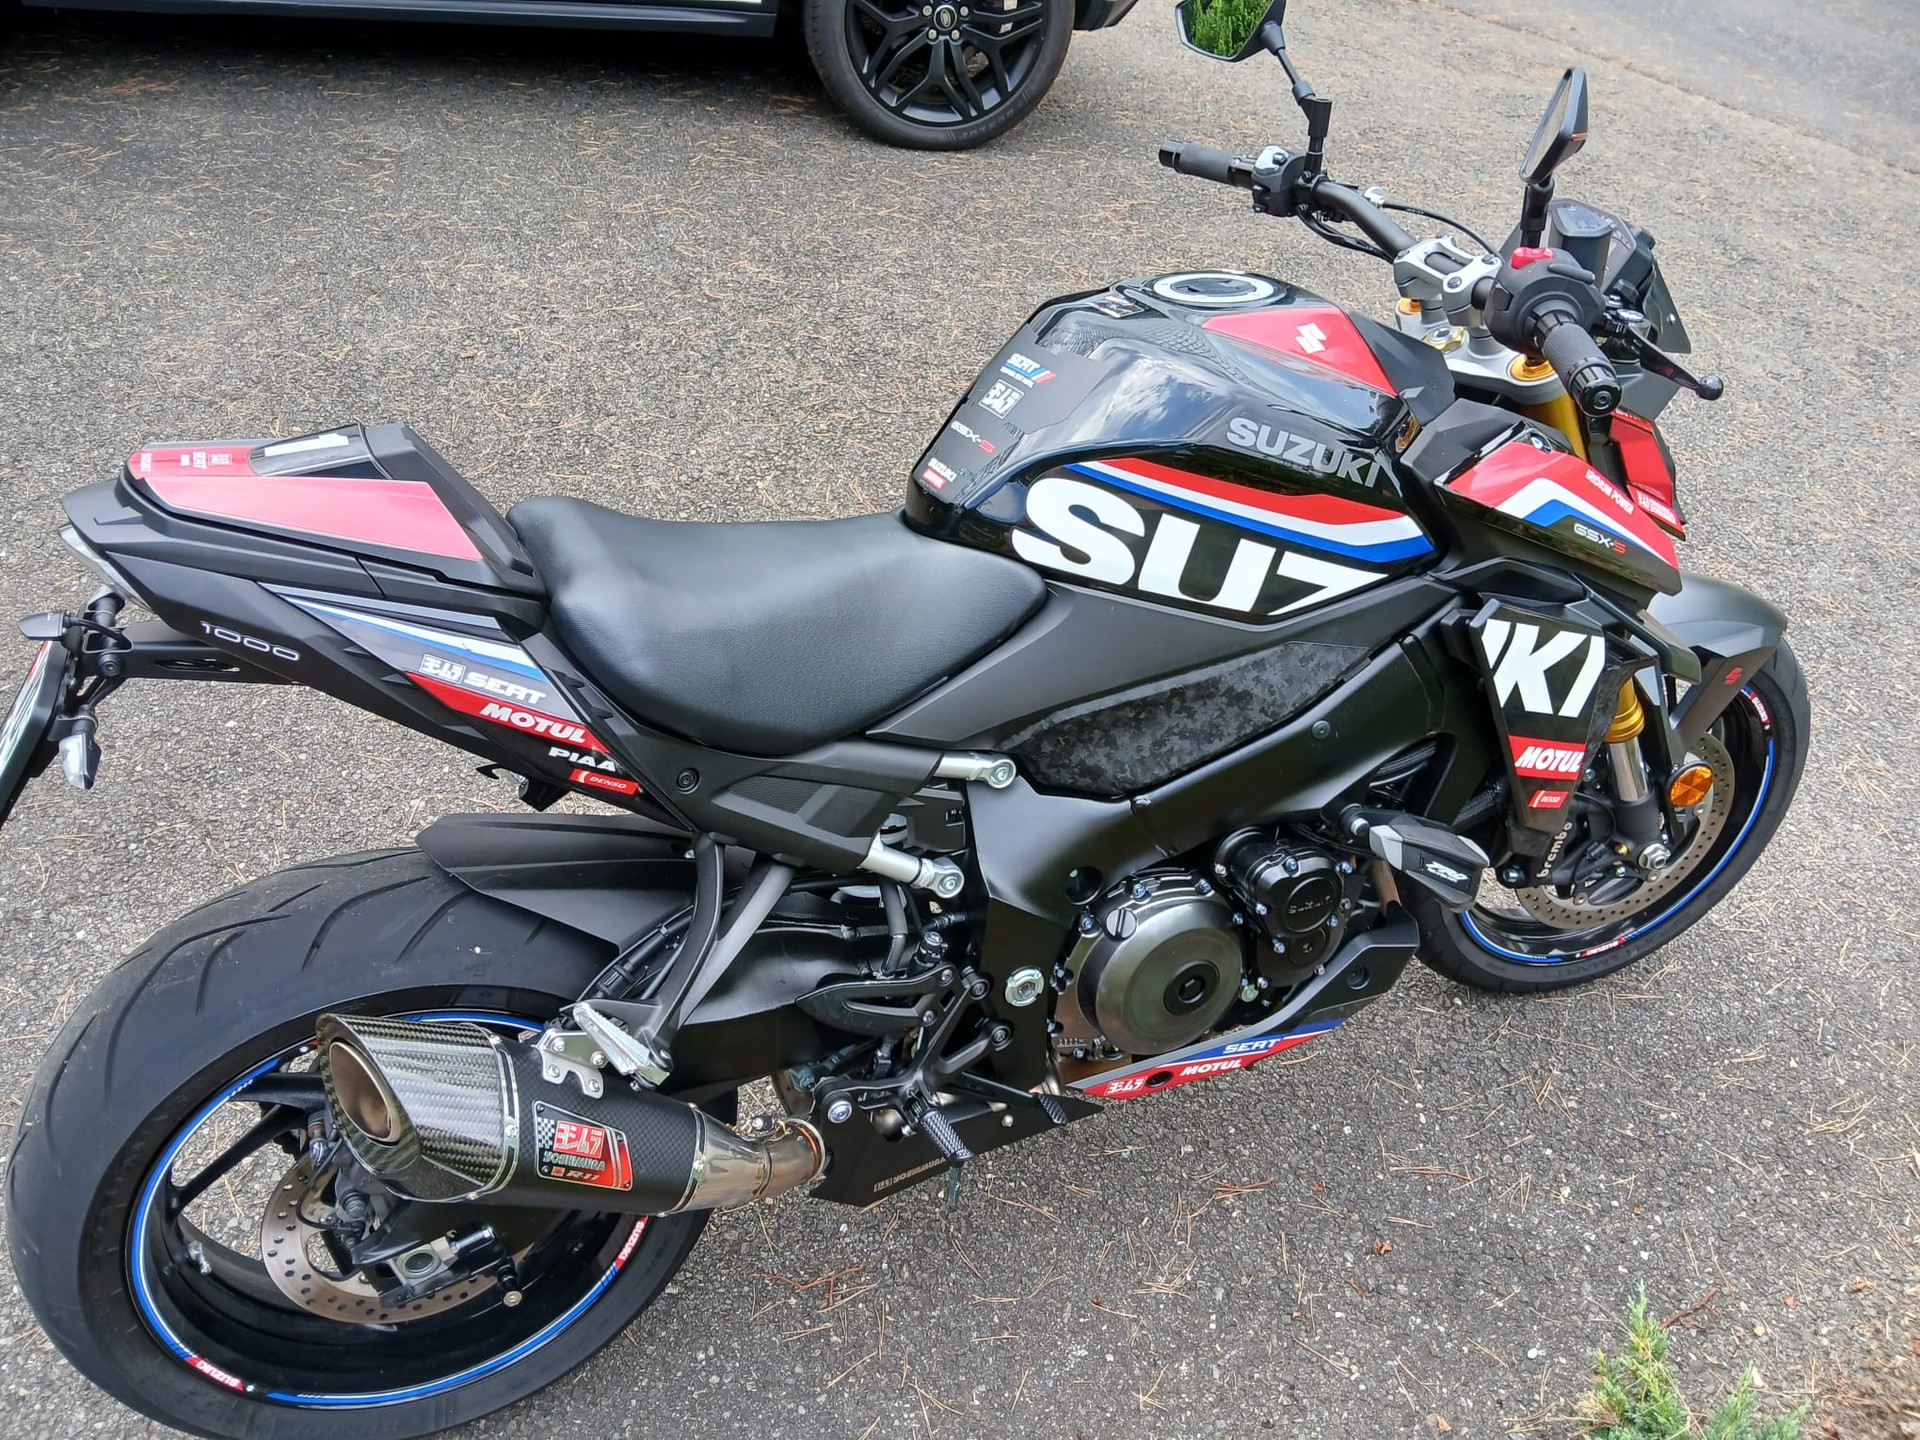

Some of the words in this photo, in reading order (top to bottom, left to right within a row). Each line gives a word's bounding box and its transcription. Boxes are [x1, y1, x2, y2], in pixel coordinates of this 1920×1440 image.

[1227, 417, 1381, 488] SUZUKI
[1585, 469, 1612, 497] IRIDIUM
[1611, 489, 1634, 515] POWER
[1574, 522, 1627, 554] GSX-S
[200, 621, 299, 661] 1000
[464, 672, 546, 704] SERT
[480, 702, 586, 744] MOTUL
[549, 746, 617, 773] PIAA
[1515, 745, 1584, 773] MOTUL
[589, 775, 627, 789] DENSO
[1540, 795, 1561, 804] DENSO
[1536, 821, 1573, 878] brembo
[1222, 1038, 1280, 1054] SERT
[1180, 1059, 1242, 1077] MOTUL
[543, 1150, 606, 1172] YOSHIMURA
[618, 1220, 646, 1261] SUZUKI
[195, 1360, 241, 1389] SUZUKI
